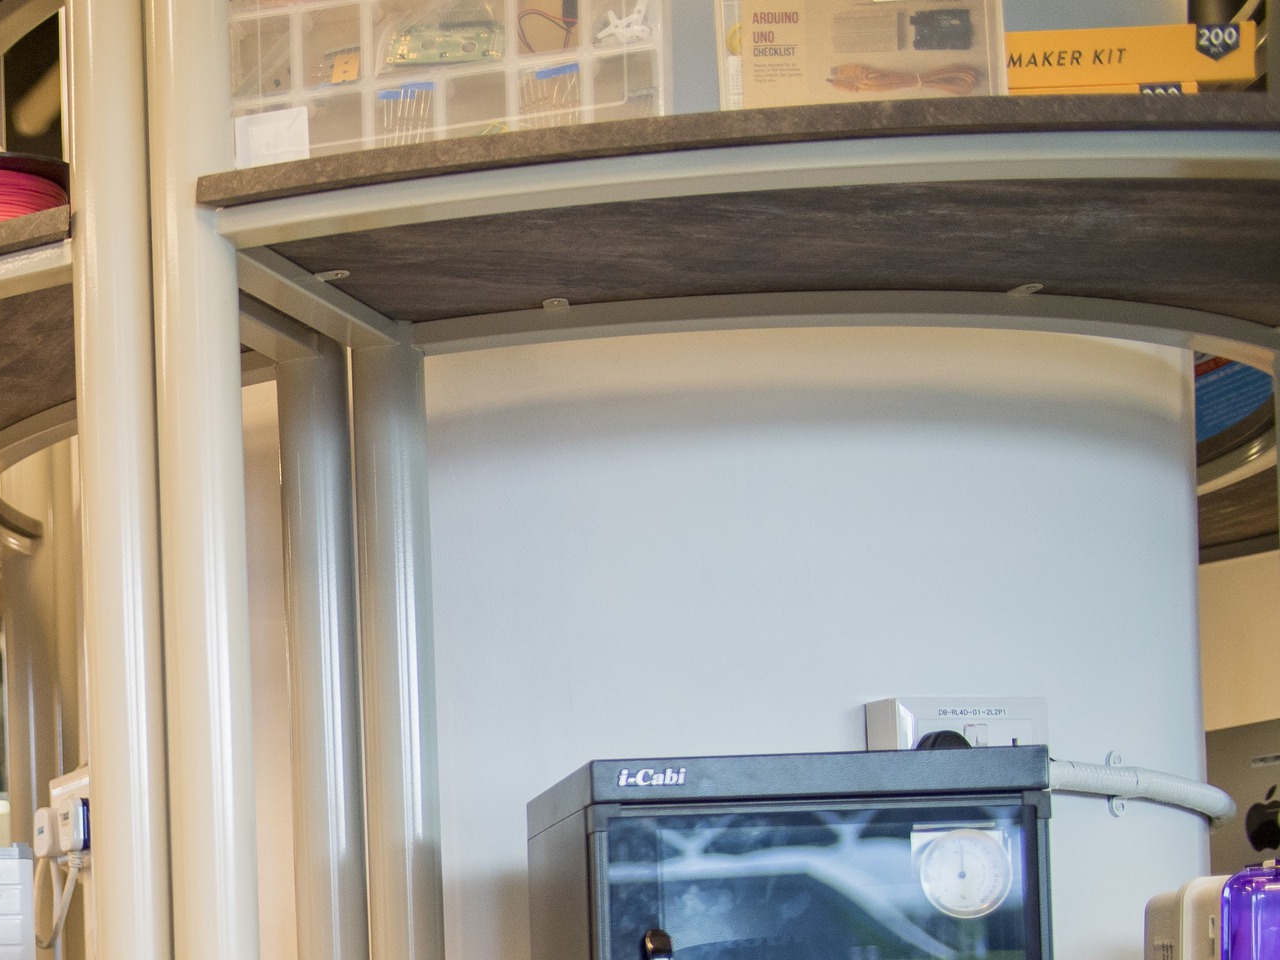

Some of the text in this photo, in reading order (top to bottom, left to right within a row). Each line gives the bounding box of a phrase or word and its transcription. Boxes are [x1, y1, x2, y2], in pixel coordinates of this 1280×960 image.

[752, 11, 799, 24] ARDUINO
[752, 30, 775, 43] UNO
[1199, 27, 1237, 45] 200
[752, 46, 796, 57] CHECKLIST
[1007, 48, 1127, 68] MAKER KIT
[618, 767, 686, 787] i-Cabi
